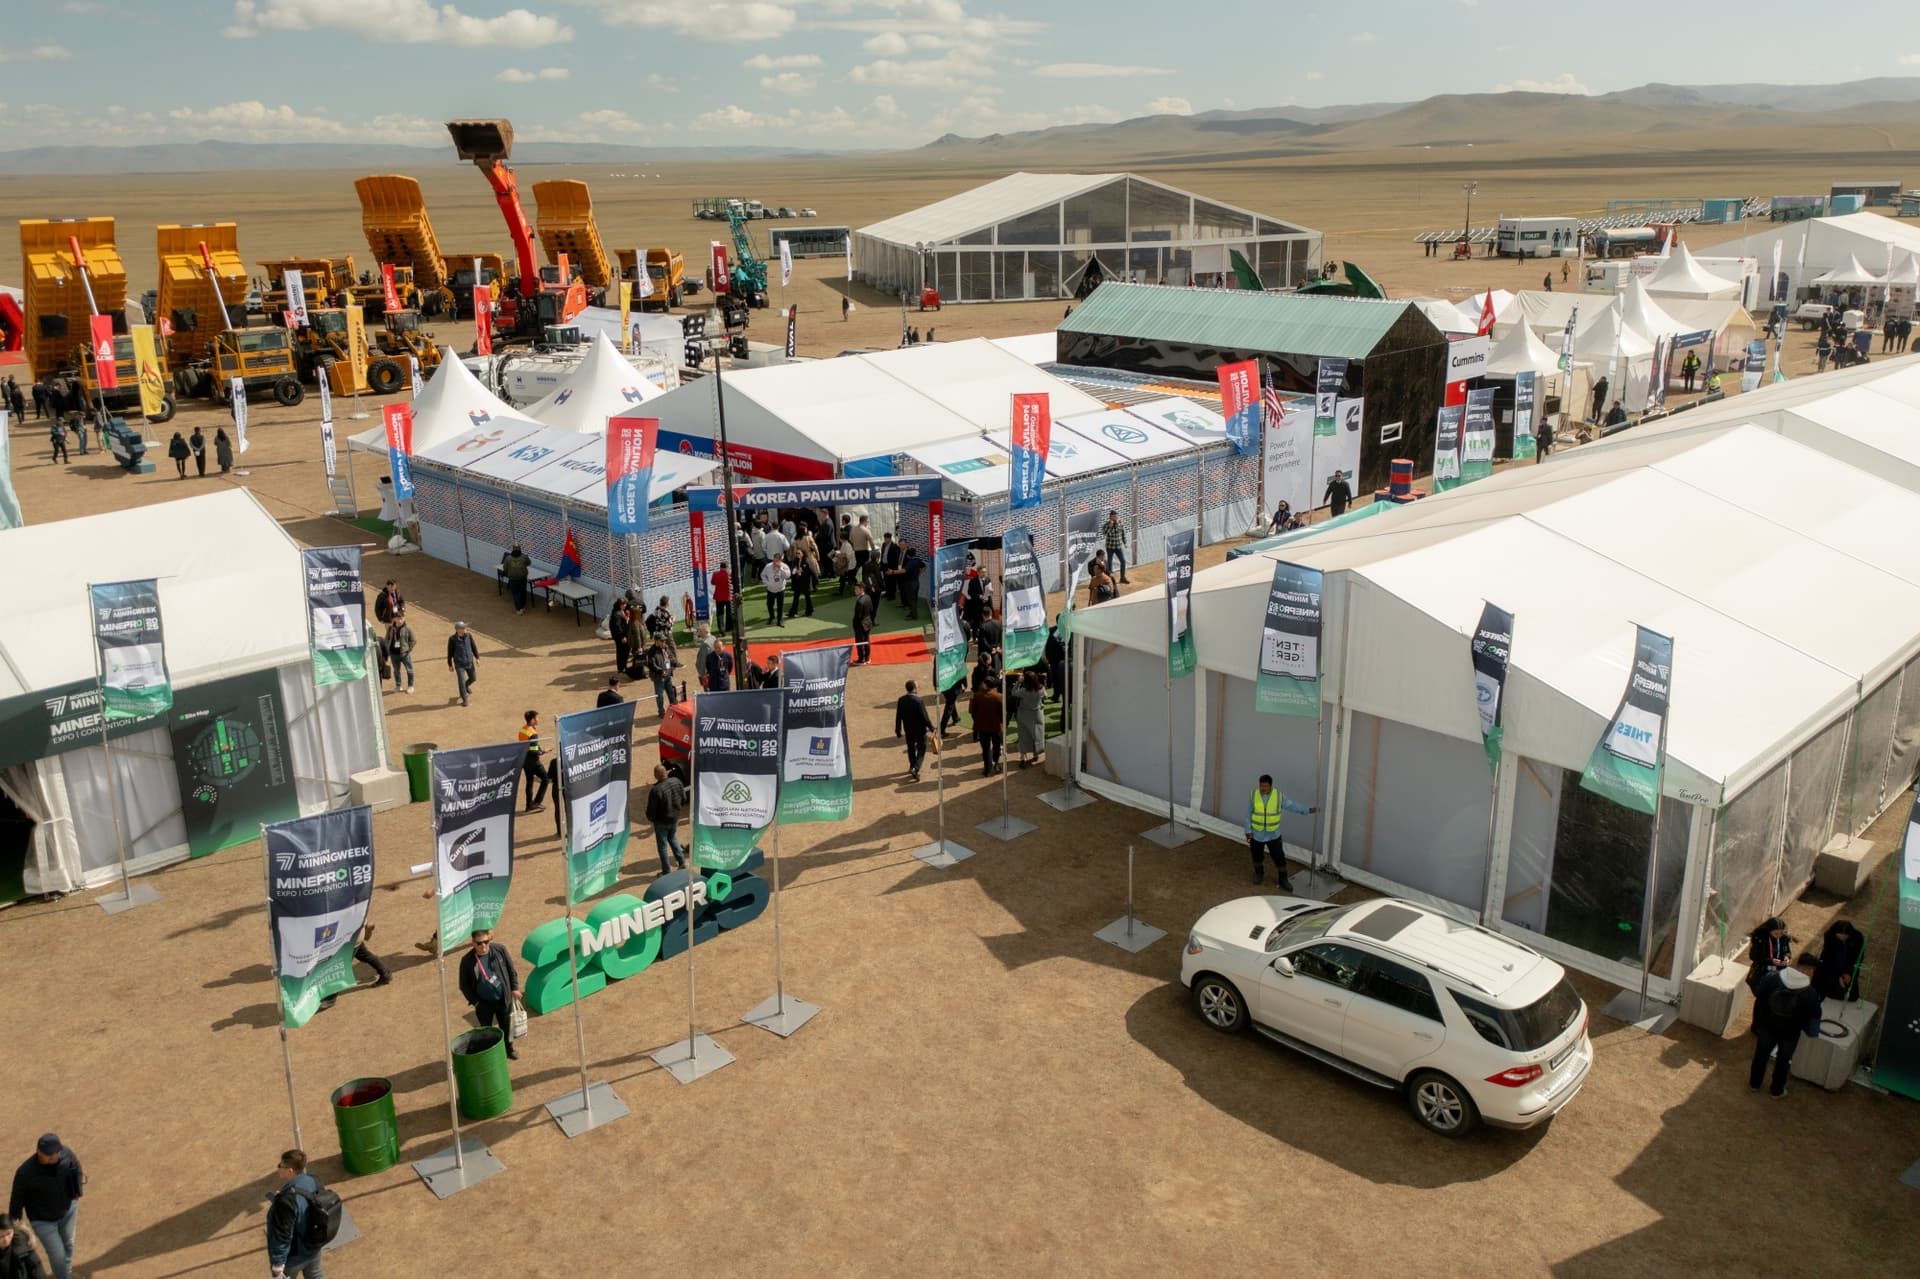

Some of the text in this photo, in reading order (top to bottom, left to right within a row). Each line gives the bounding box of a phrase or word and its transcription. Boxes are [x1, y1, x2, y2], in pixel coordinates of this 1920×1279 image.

[1452, 352, 1485, 367] Cummins
[1022, 404, 1031, 457] PAVILION
[1269, 438, 1295, 450] Power of
[1269, 451, 1295, 462] expertise
[1268, 459, 1301, 473] everywhere
[746, 492, 798, 504] KOREA
[800, 489, 870, 502] PAVILION
[309, 580, 347, 592] MINEPRO
[99, 618, 143, 632] MINEPRO
[789, 694, 839, 708] MINEPRO
[717, 723, 777, 733] MININGWEEK
[53, 733, 75, 745] EXPO
[577, 733, 627, 756] MININGWEEK
[699, 737, 778, 750] MINEPRO 20
[762, 747, 778, 757] 25
[568, 749, 627, 778] MINEPRO 20
[440, 790, 497, 813] MINEPRO
[449, 827, 484, 863] Cummins
[298, 846, 369, 871] MININGWEEK
[277, 863, 371, 889] MINEPRO 20
[353, 873, 372, 886] 25
[276, 880, 349, 897] EXPO CONVENTION
[579, 872, 732, 957] MINEPRO
